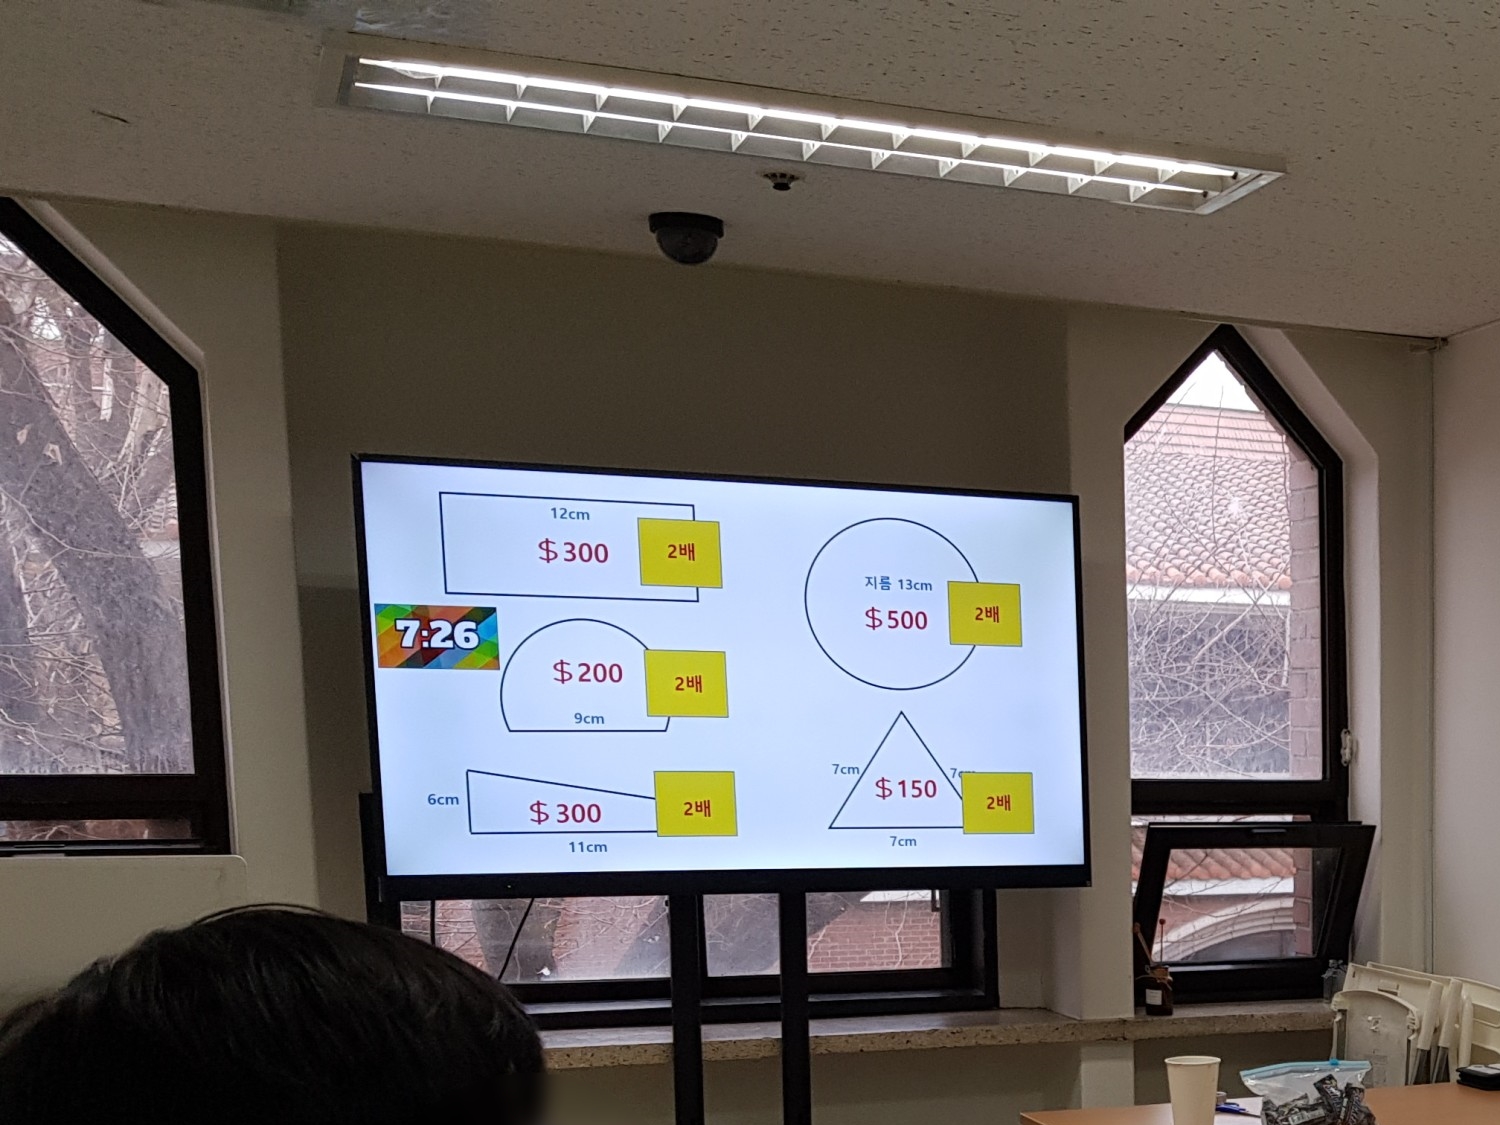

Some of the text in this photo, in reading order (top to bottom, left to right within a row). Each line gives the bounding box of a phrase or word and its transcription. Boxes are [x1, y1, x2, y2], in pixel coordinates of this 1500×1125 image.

[550, 507, 591, 521] 12cm
[538, 537, 610, 564] $300
[667, 542, 696, 562] 2배
[864, 575, 933, 592] 지름 13cm
[865, 606, 928, 630] $500
[974, 605, 1000, 624] 2배
[395, 618, 480, 650] 7:26
[552, 659, 623, 685] $200
[674, 674, 703, 694] 2배
[573, 712, 605, 725] 9cm
[831, 763, 861, 775] 7cm
[875, 776, 937, 801] $150
[427, 793, 460, 806] 6cm
[683, 799, 712, 818] 2배
[986, 794, 1011, 812] 2배
[568, 841, 608, 853] 11cm
[889, 835, 917, 847] 7cm
